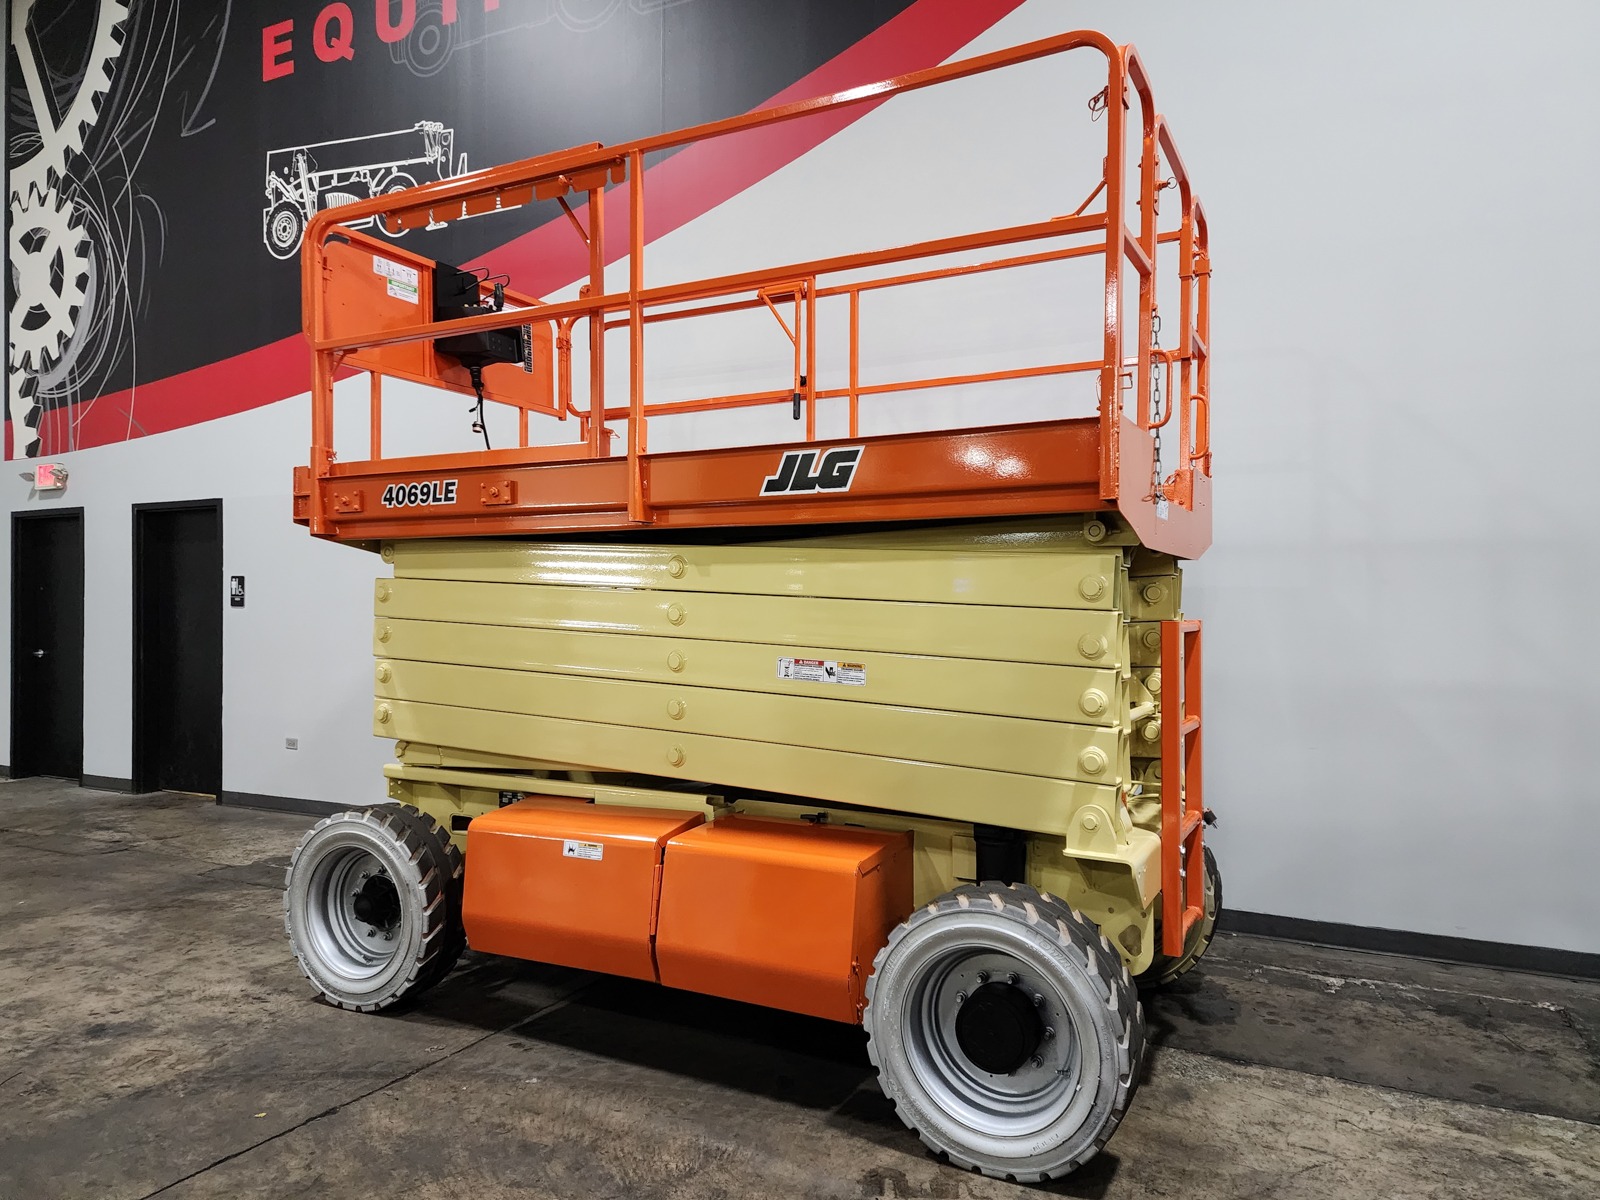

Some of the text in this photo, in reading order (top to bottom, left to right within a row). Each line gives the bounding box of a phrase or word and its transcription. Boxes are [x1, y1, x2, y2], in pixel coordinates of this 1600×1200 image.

[263, 0, 499, 82] EQU
[382, 480, 458, 507] 4069LE
[761, 447, 864, 495] JLG
